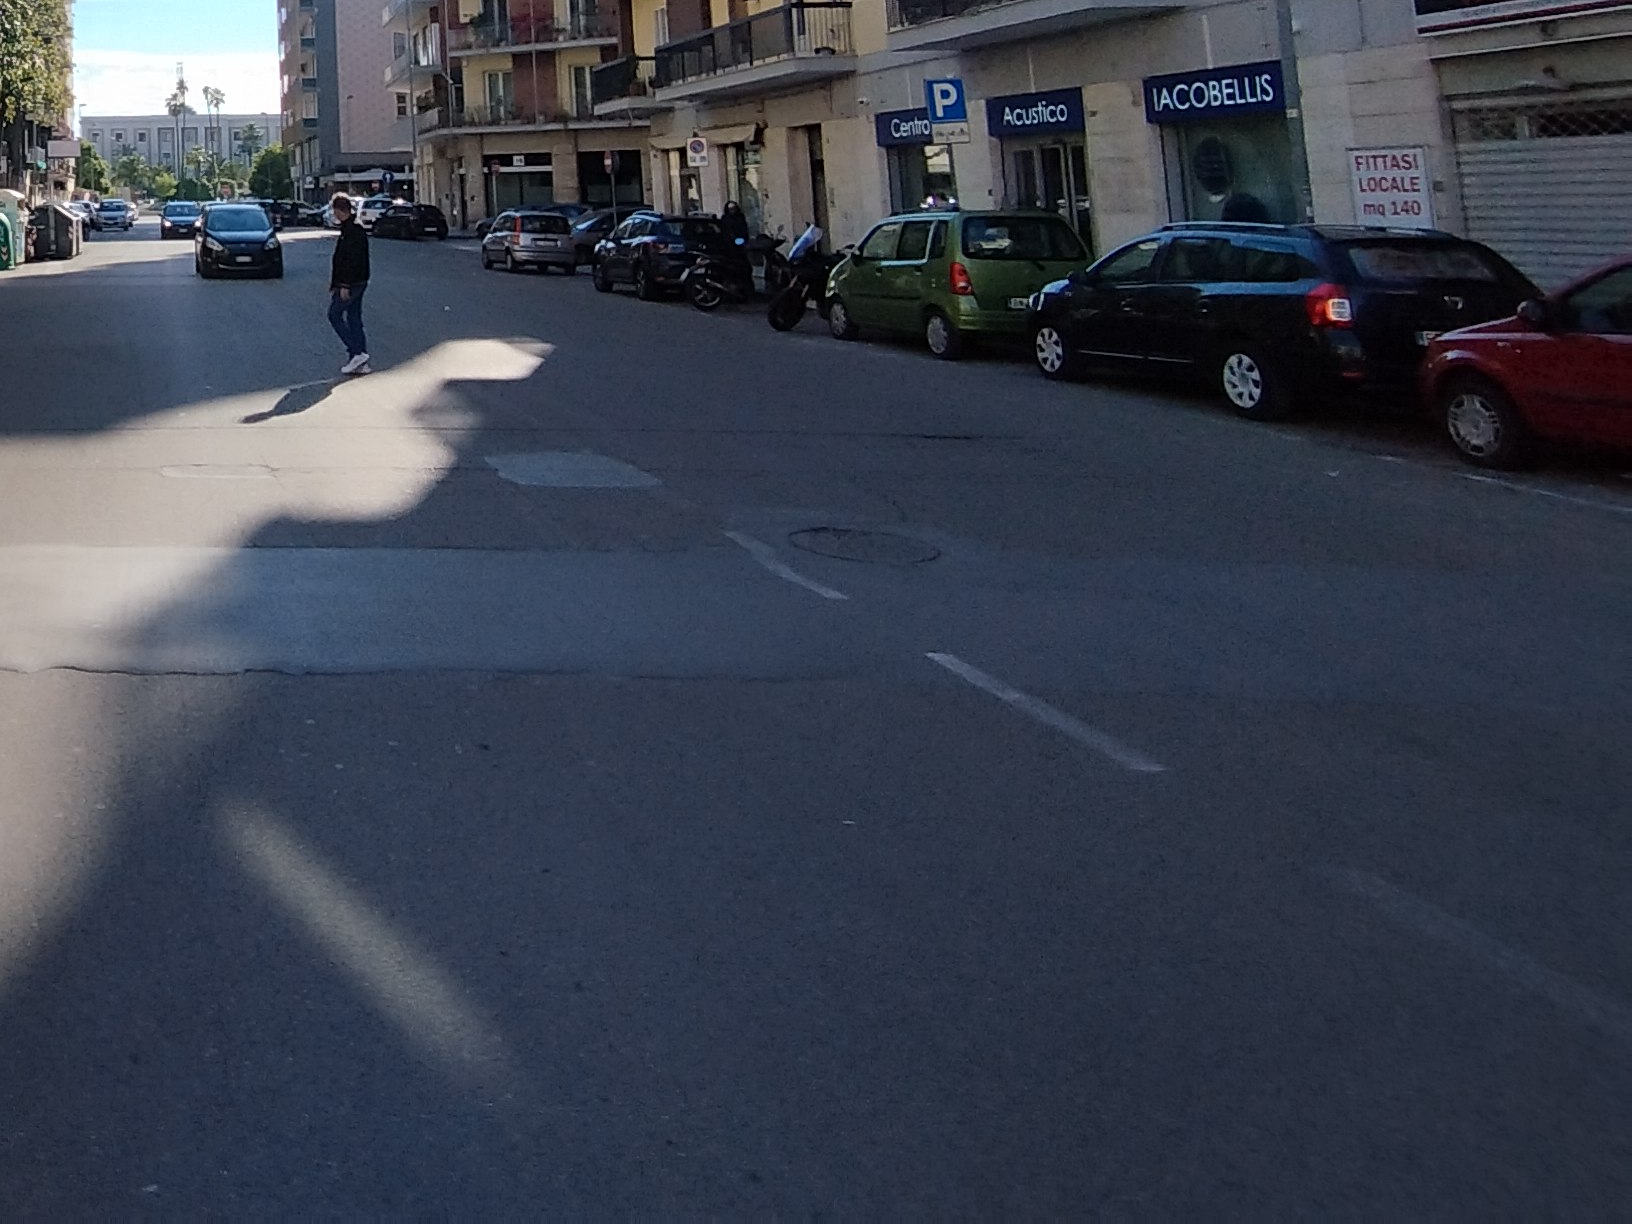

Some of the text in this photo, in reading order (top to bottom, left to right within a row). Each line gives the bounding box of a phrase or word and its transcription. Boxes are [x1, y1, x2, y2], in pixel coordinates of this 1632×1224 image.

[933, 83, 958, 117] P
[1152, 73, 1274, 112] IACOBELLIS
[890, 118, 931, 138] Centro
[1002, 101, 1068, 126] Acustico
[1354, 154, 1419, 172] FITTASI
[1358, 177, 1421, 193] LOCALE
[1363, 200, 1422, 217] mq 140
